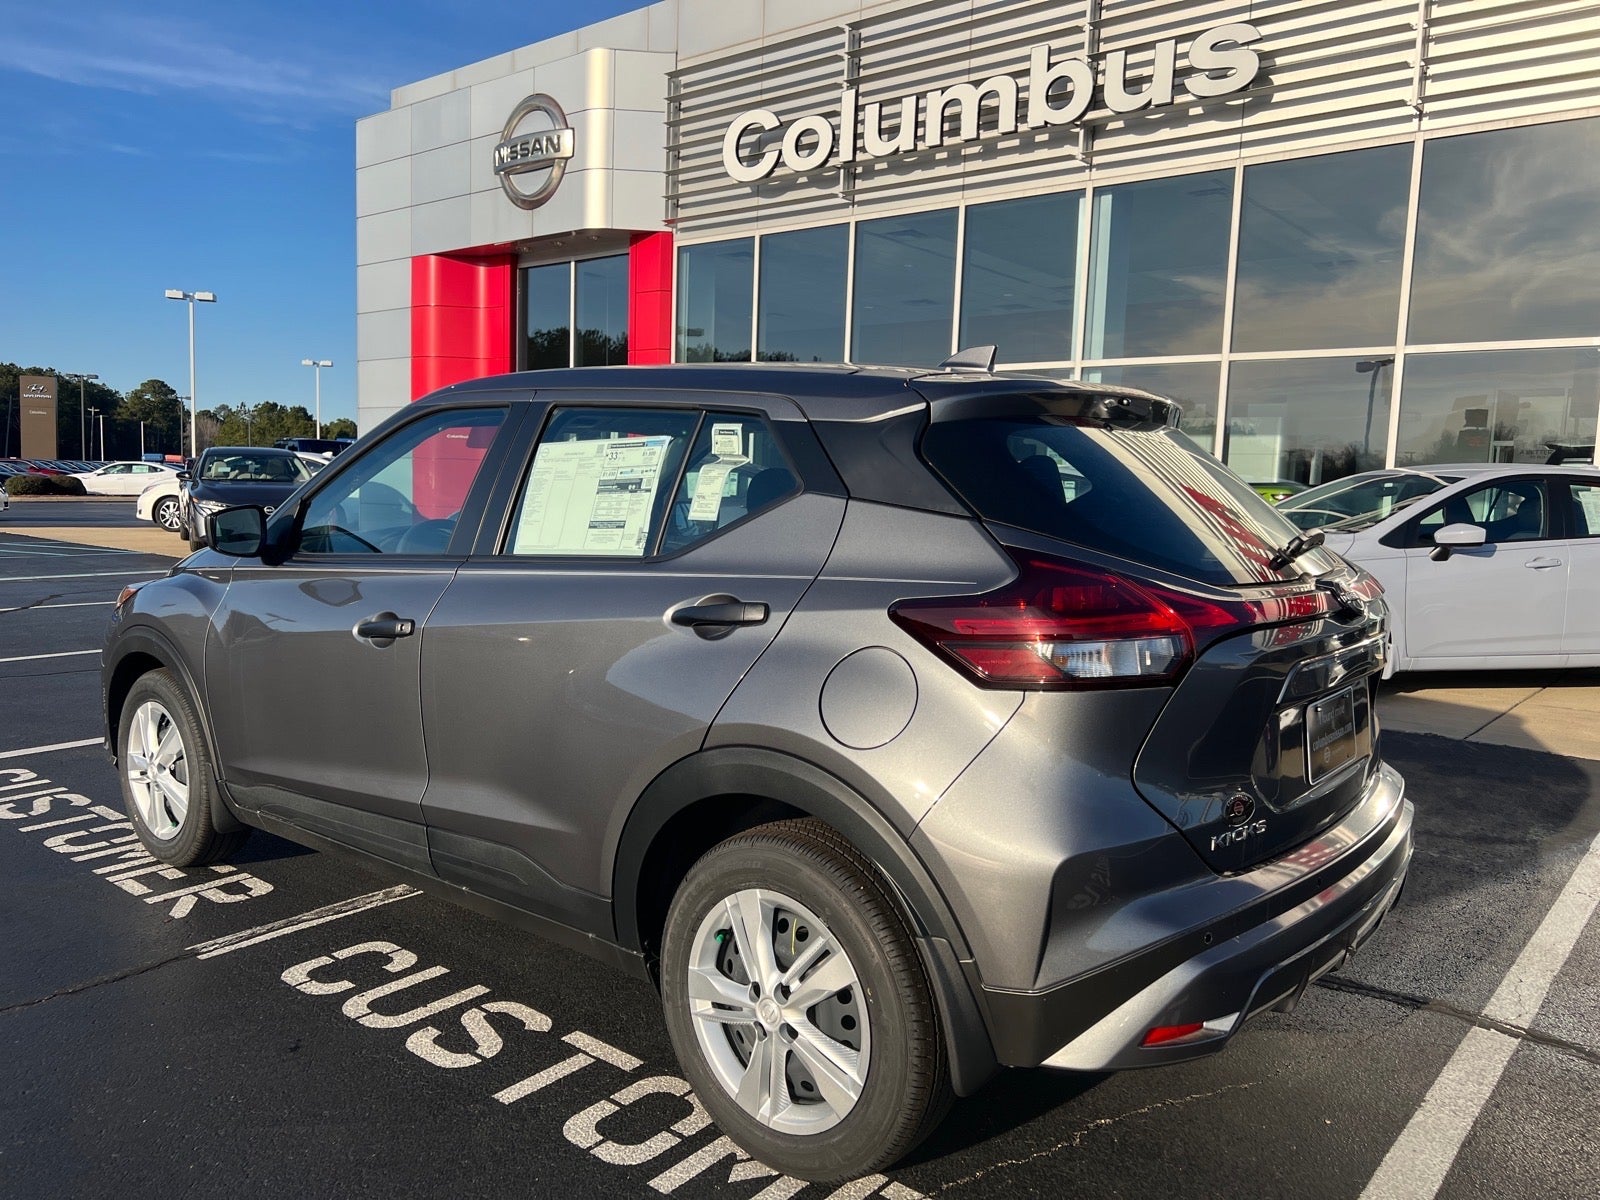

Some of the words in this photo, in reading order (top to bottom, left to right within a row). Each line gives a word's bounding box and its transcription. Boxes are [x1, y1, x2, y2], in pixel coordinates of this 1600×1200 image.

[722, 22, 1263, 183] Columbus
[495, 134, 561, 167] NISSAN
[1210, 819, 1267, 851] KICKS
